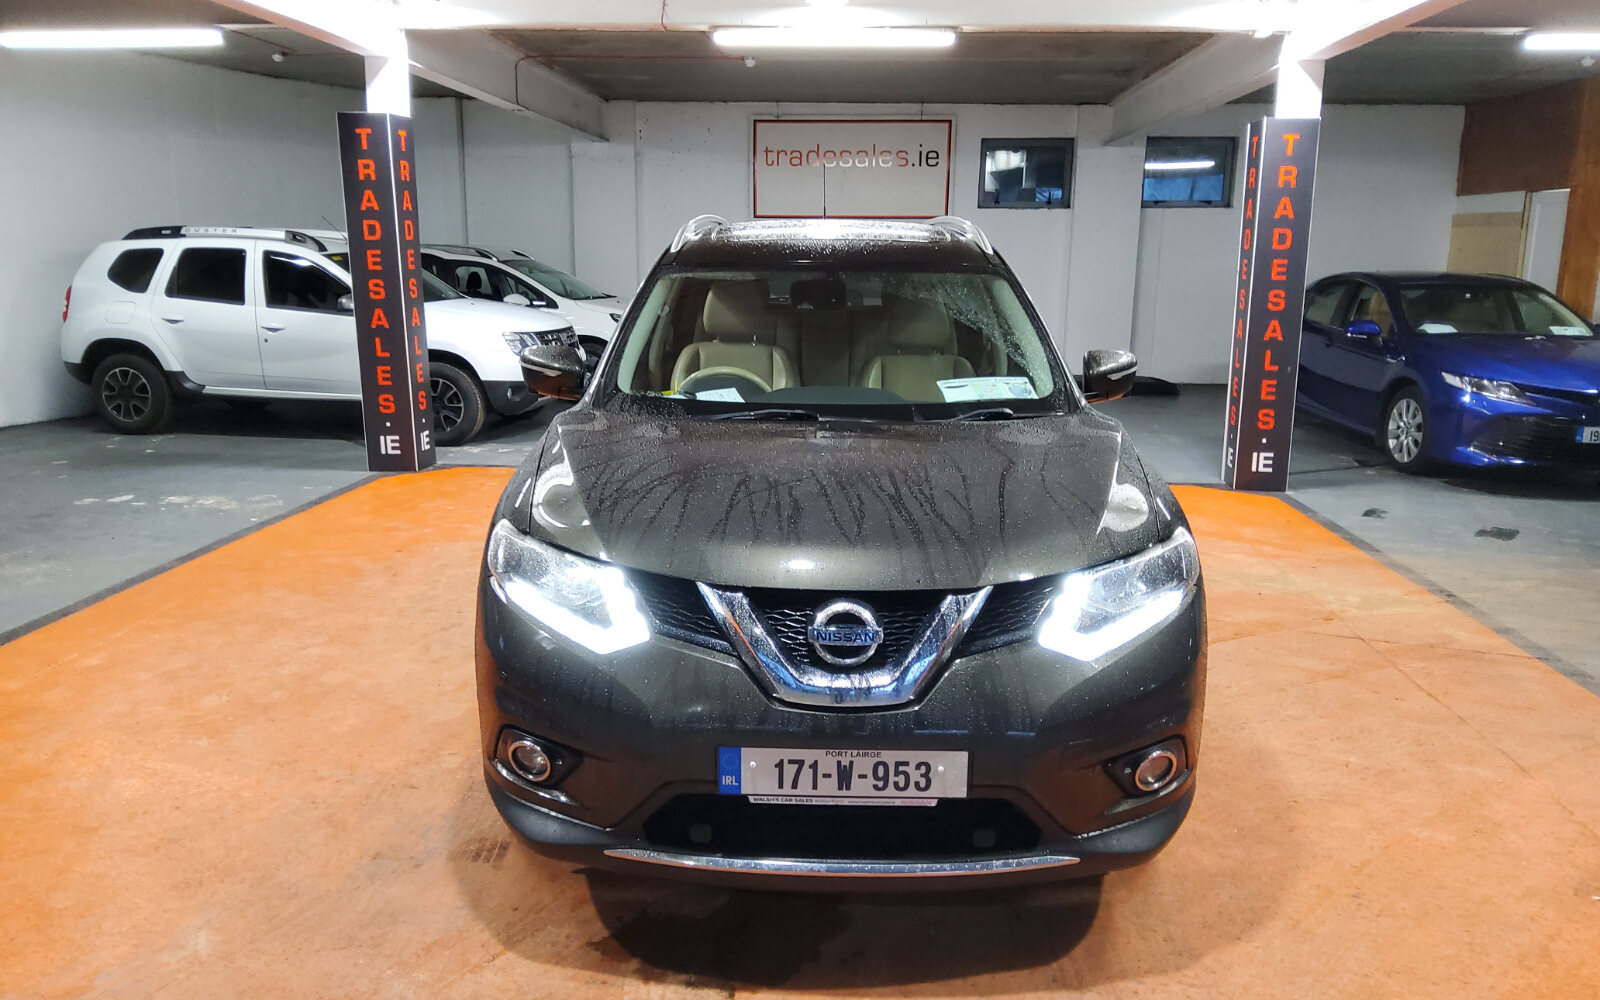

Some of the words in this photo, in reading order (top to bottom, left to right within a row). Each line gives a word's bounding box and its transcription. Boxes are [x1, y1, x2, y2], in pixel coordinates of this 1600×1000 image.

[763, 143, 940, 168] tradesales.ie
[816, 631, 875, 642] NISSAN
[825, 750, 848, 758] PORT
[722, 775, 739, 786] IRL
[774, 758, 932, 792] 171-W-953
